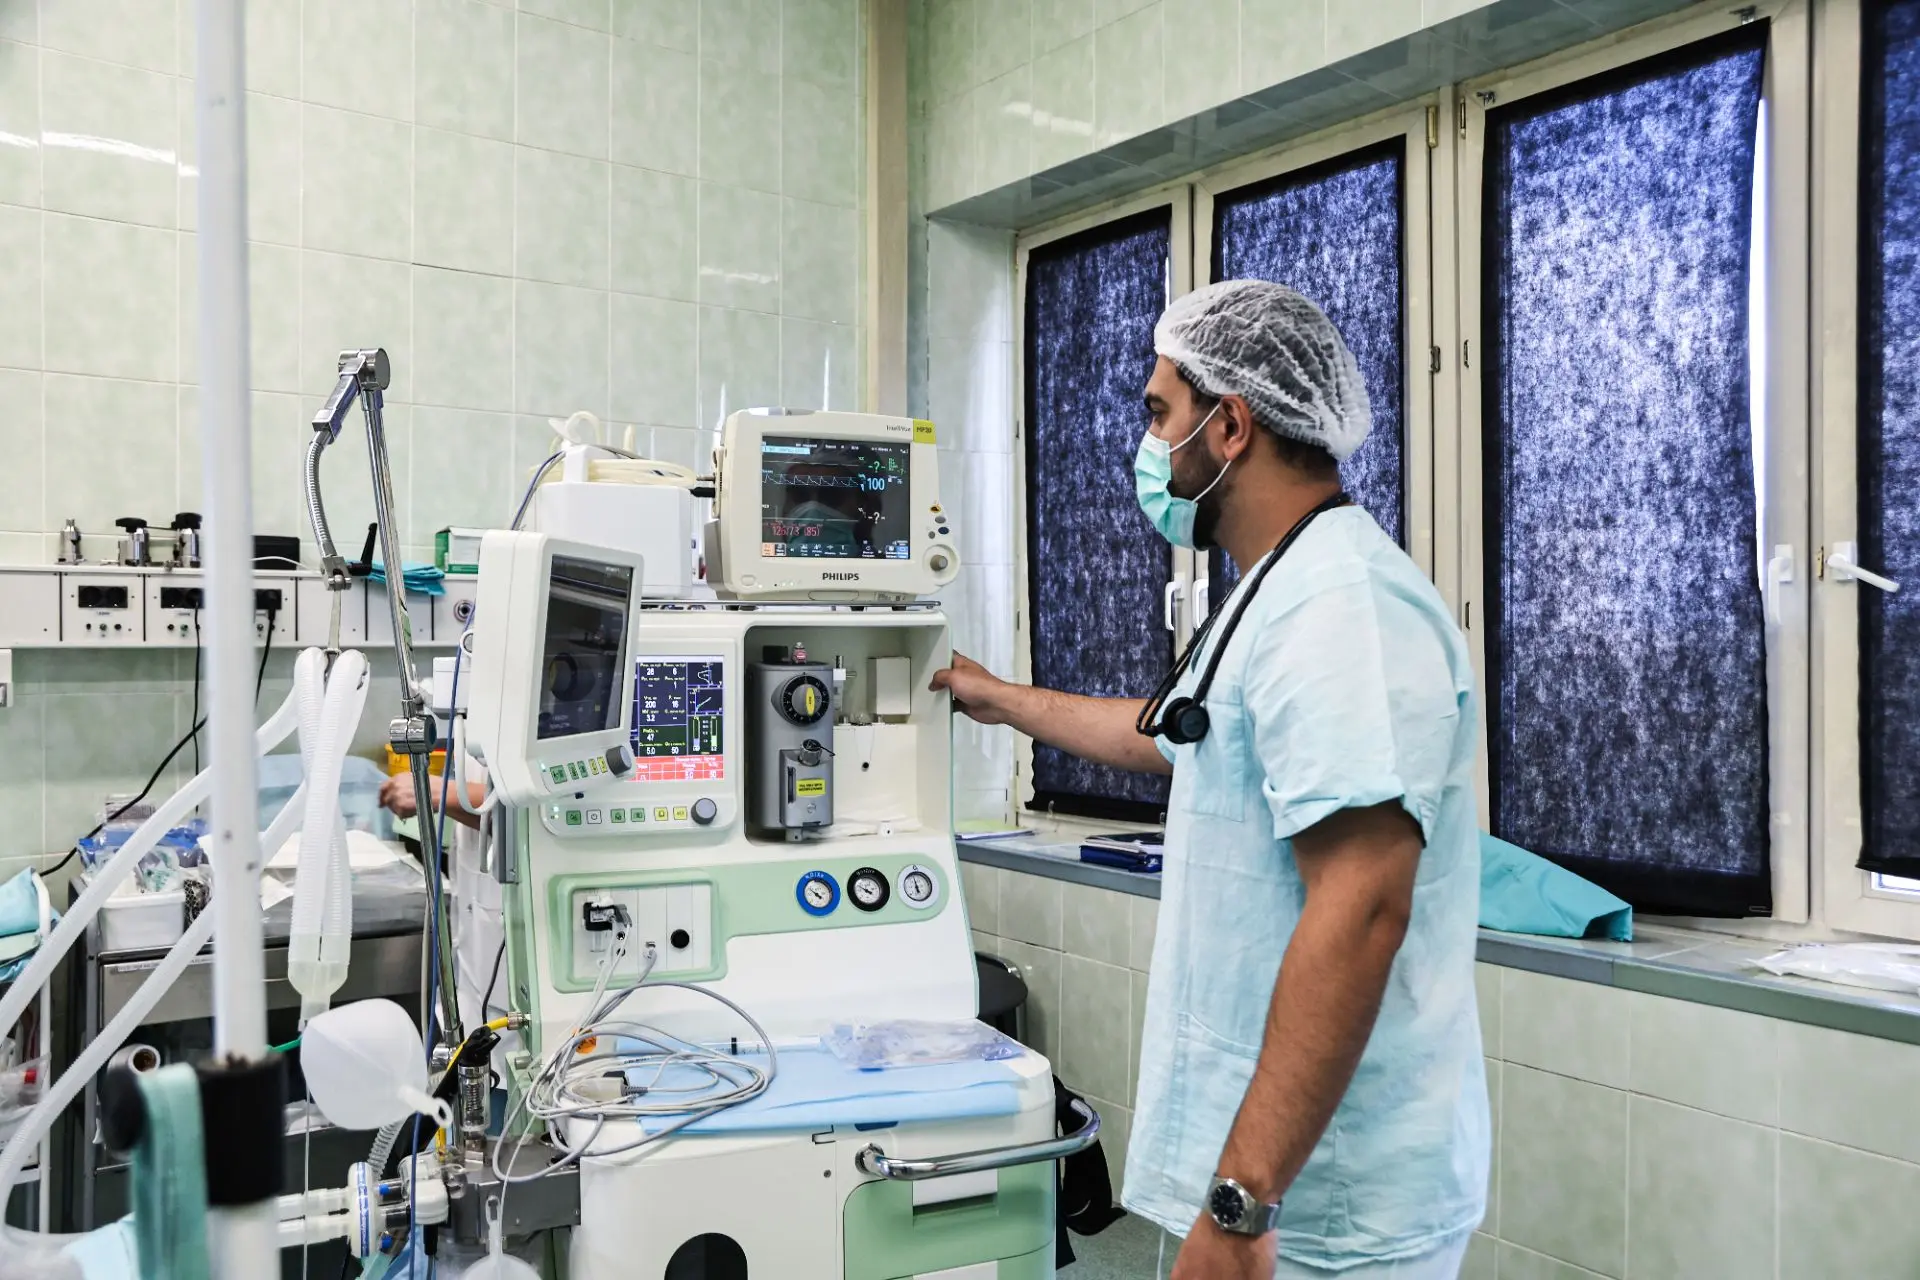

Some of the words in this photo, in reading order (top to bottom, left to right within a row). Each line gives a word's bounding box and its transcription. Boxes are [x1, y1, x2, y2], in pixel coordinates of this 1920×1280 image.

[867, 477, 885, 490] 100
[822, 572, 860, 581] PHILIPS
[646, 733, 655, 741] 47
